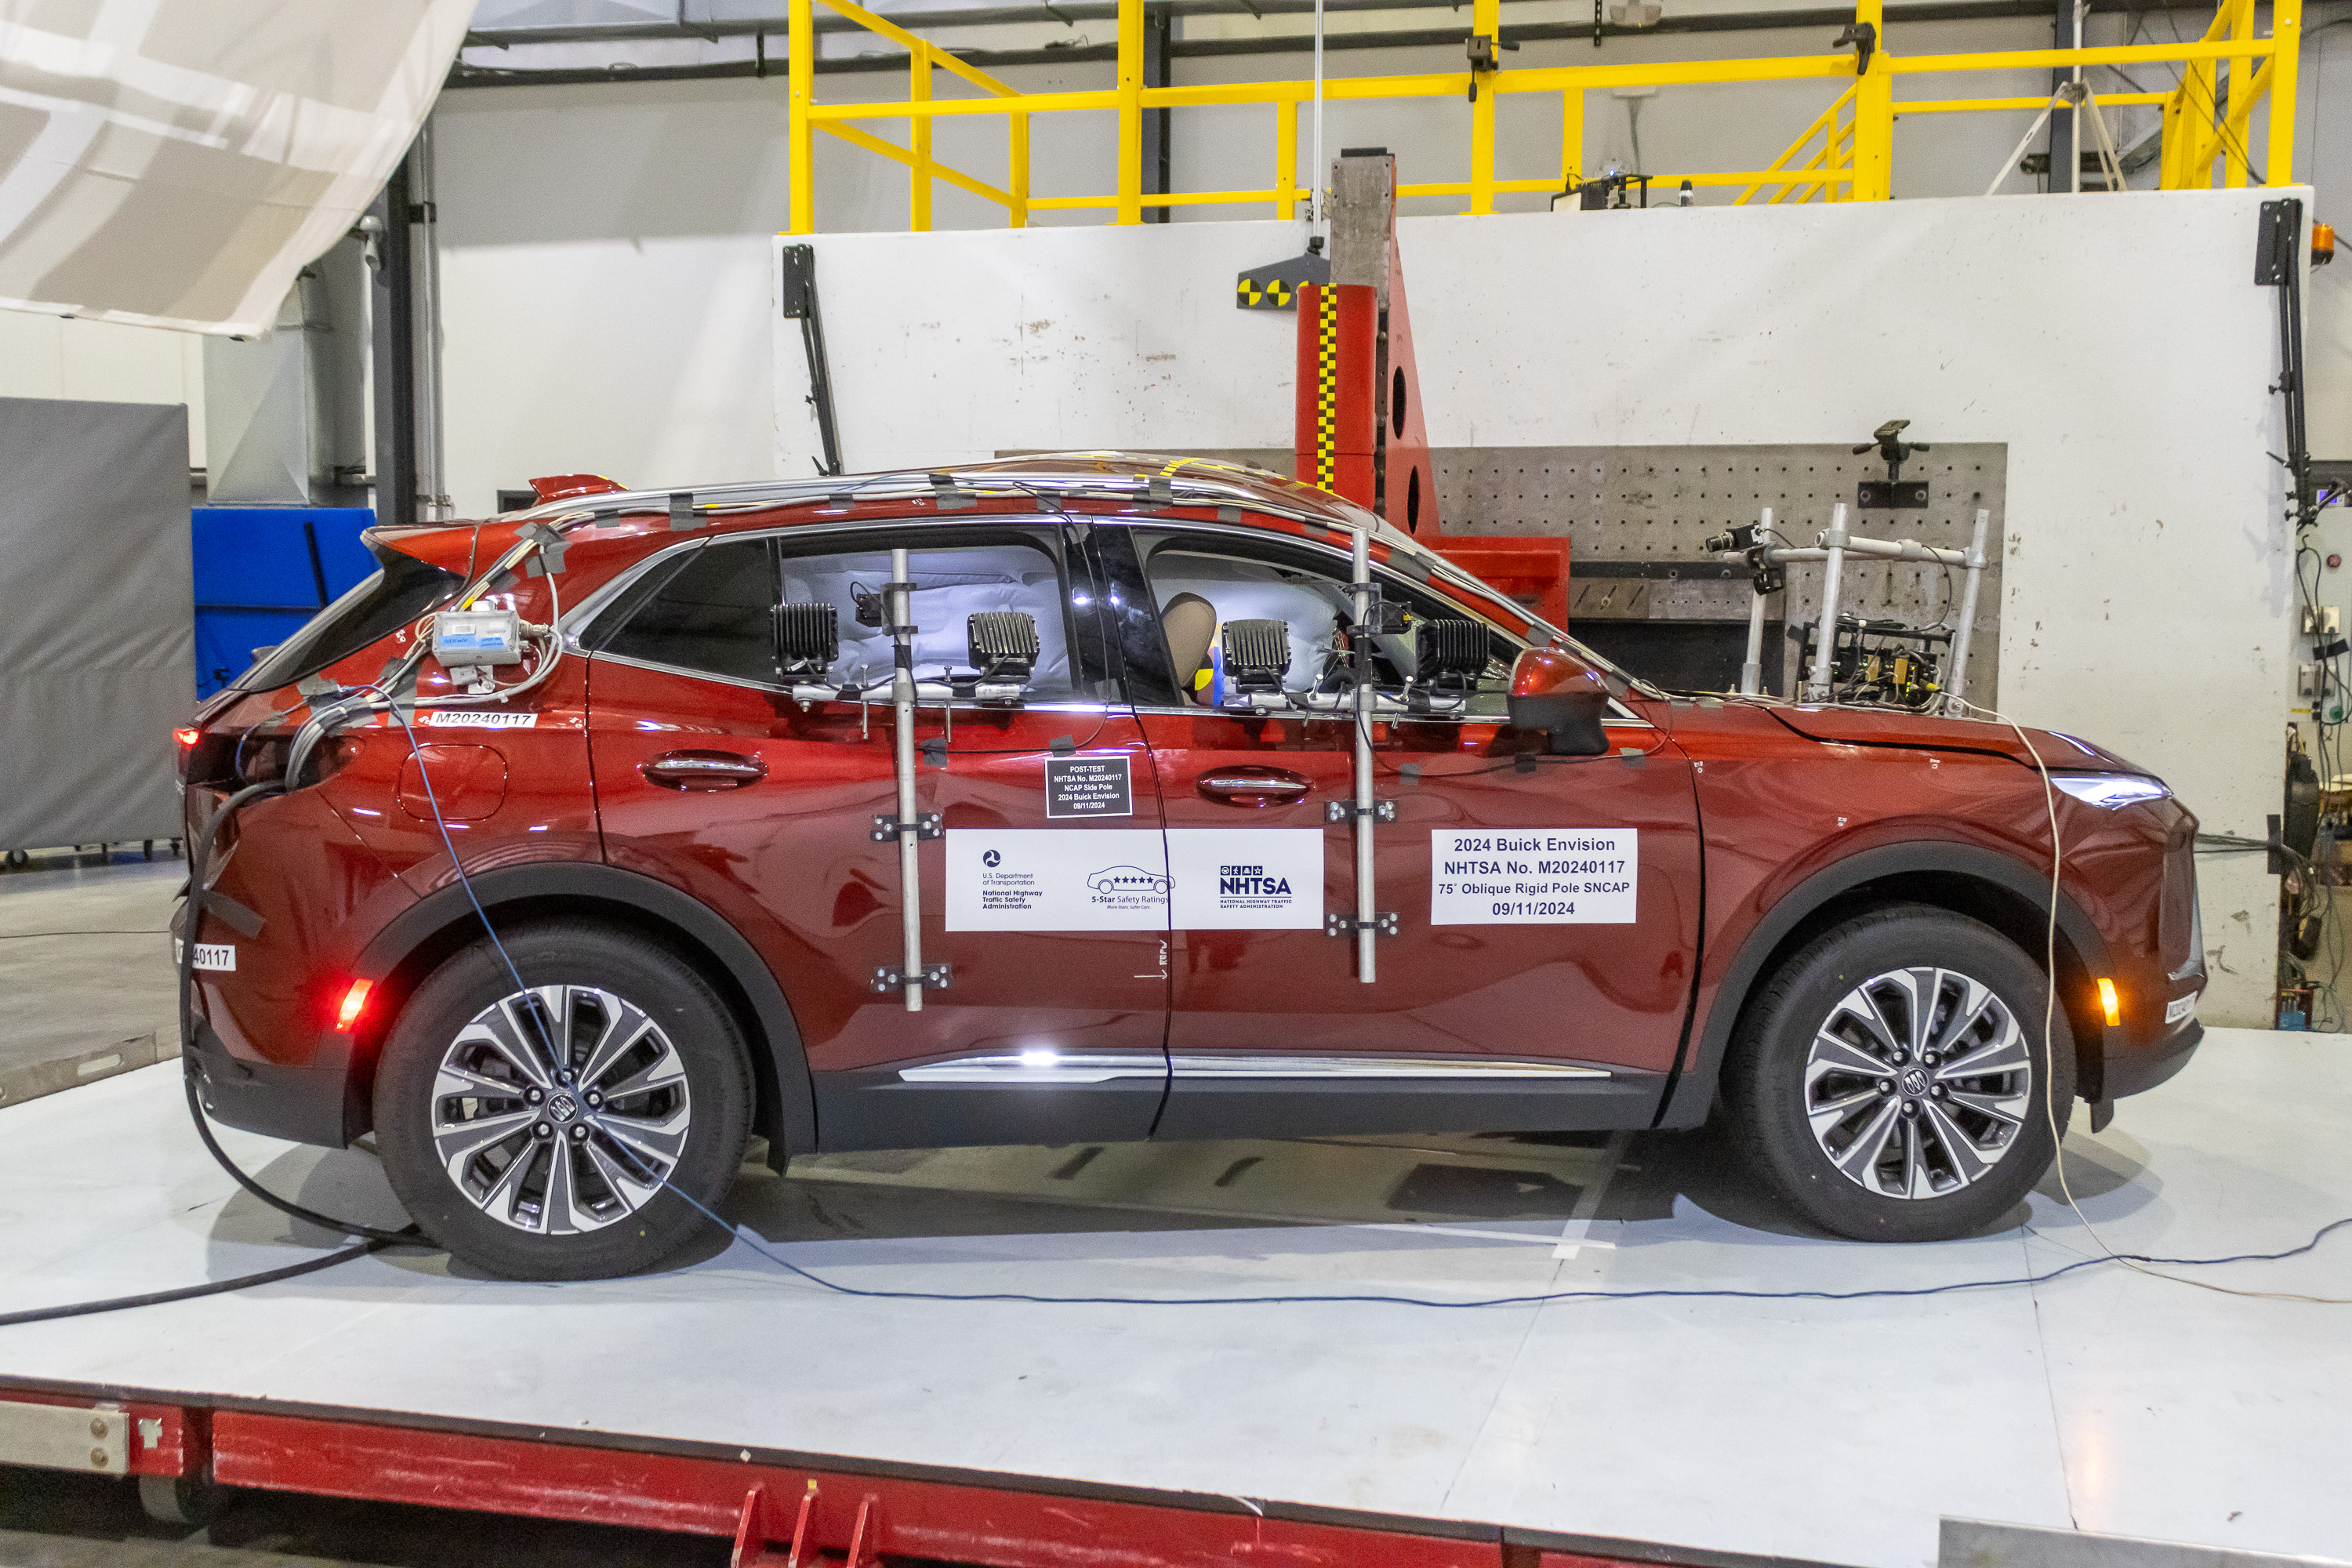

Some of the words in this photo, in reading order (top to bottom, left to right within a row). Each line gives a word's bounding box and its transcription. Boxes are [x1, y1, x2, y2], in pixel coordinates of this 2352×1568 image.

[435, 713, 532, 725] M20240117
[1454, 838, 1491, 851] 2024
[1497, 837, 1541, 851] Buick
[1547, 837, 1616, 851] Envision
[1444, 861, 1501, 875] NHTSA
[1507, 861, 1533, 874] No.
[1538, 860, 1625, 874] M20240117
[1220, 877, 1292, 895] NHTSA
[1438, 883, 1458, 895] 75°
[1461, 883, 1512, 896] Oblique
[1515, 883, 1548, 895] Rigid
[1552, 883, 1580, 893] Pole
[1584, 882, 1630, 893] SNCAP
[1117, 895, 1140, 904] Safety
[1142, 895, 1169, 905] Ratings
[1492, 902, 1575, 916] 09/11/2024
